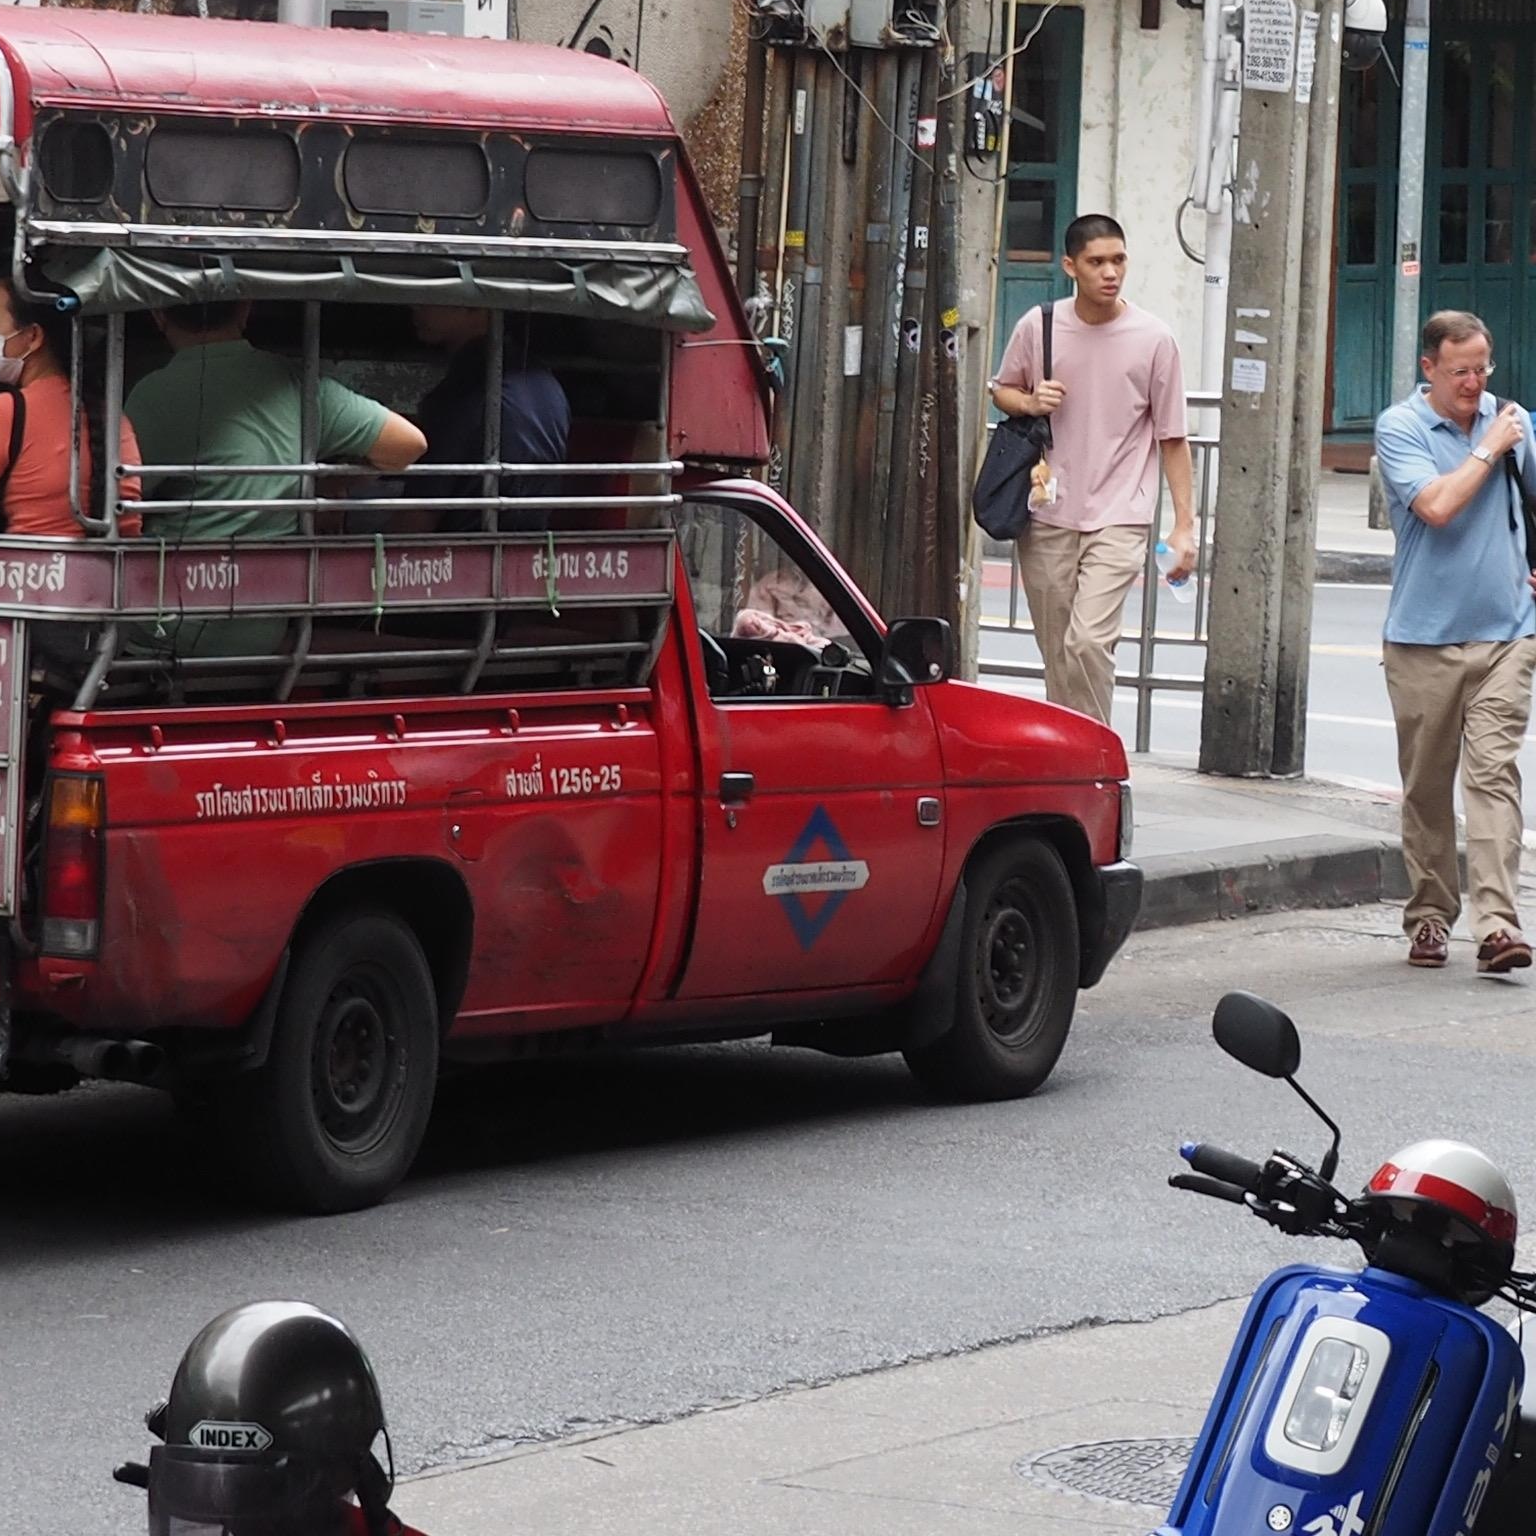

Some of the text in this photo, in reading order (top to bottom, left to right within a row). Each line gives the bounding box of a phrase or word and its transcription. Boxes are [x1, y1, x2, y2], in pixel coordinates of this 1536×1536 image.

[186, 555, 240, 592] บางรัก
[505, 752, 622, 798] สายที่ 1256-25
[200, 1428, 259, 1449] INDEX
